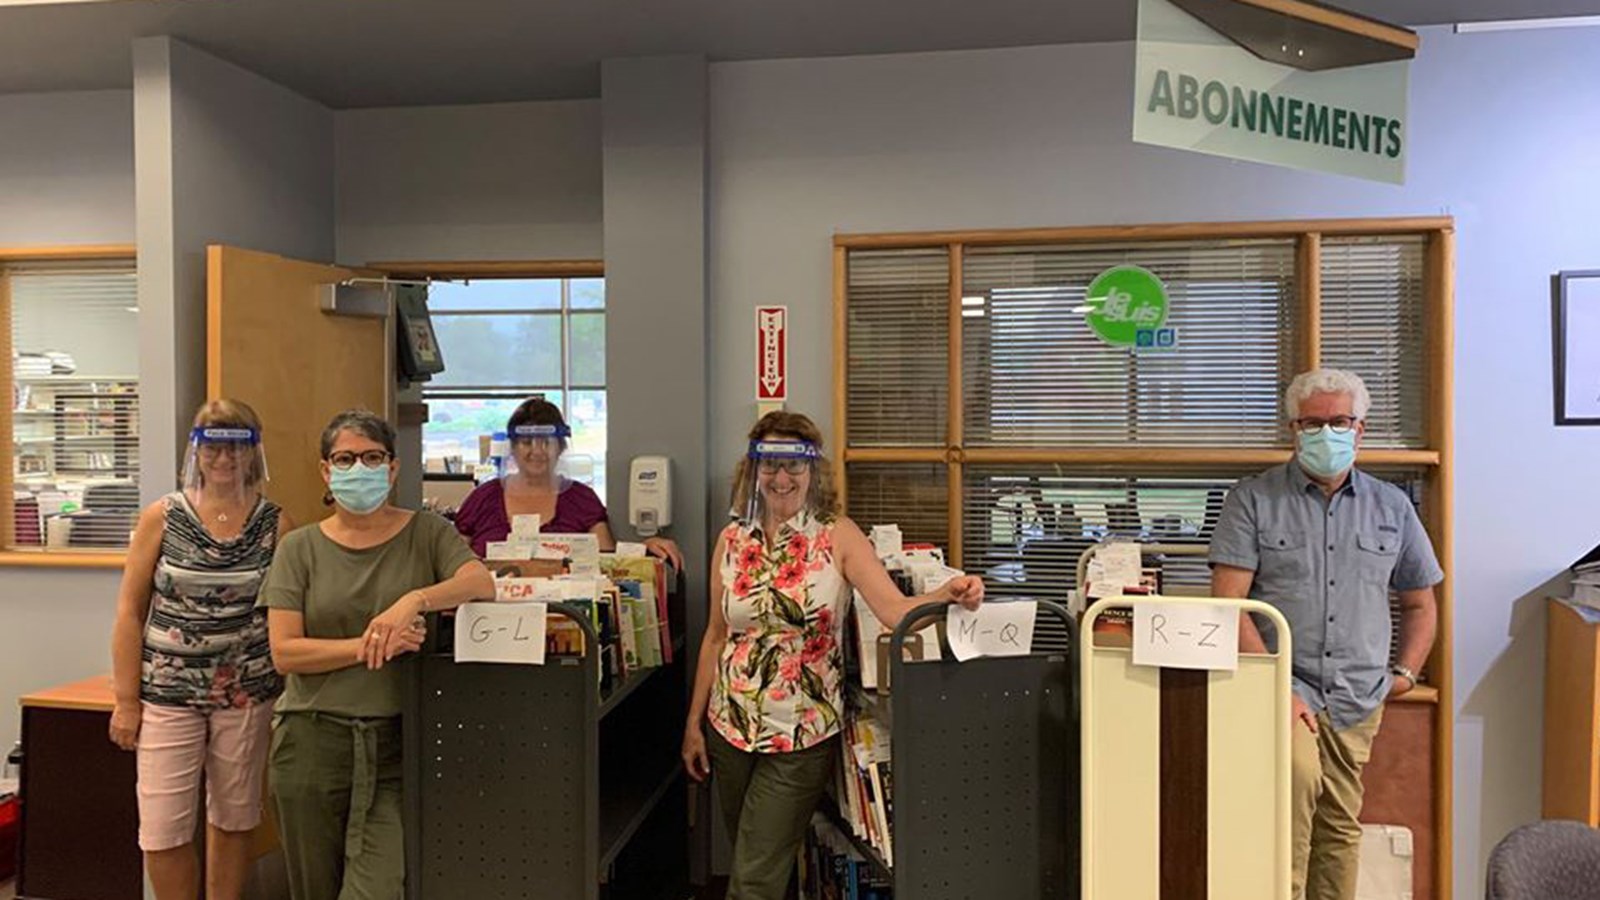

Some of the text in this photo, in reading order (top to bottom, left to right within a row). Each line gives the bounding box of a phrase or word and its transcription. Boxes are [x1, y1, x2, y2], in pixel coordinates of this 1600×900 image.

[1147, 69, 1401, 158] ABONNEMENTS
[767, 316, 776, 387] EXTINCTEUR
[469, 615, 530, 643] G-L
[958, 618, 1021, 648] M-Q
